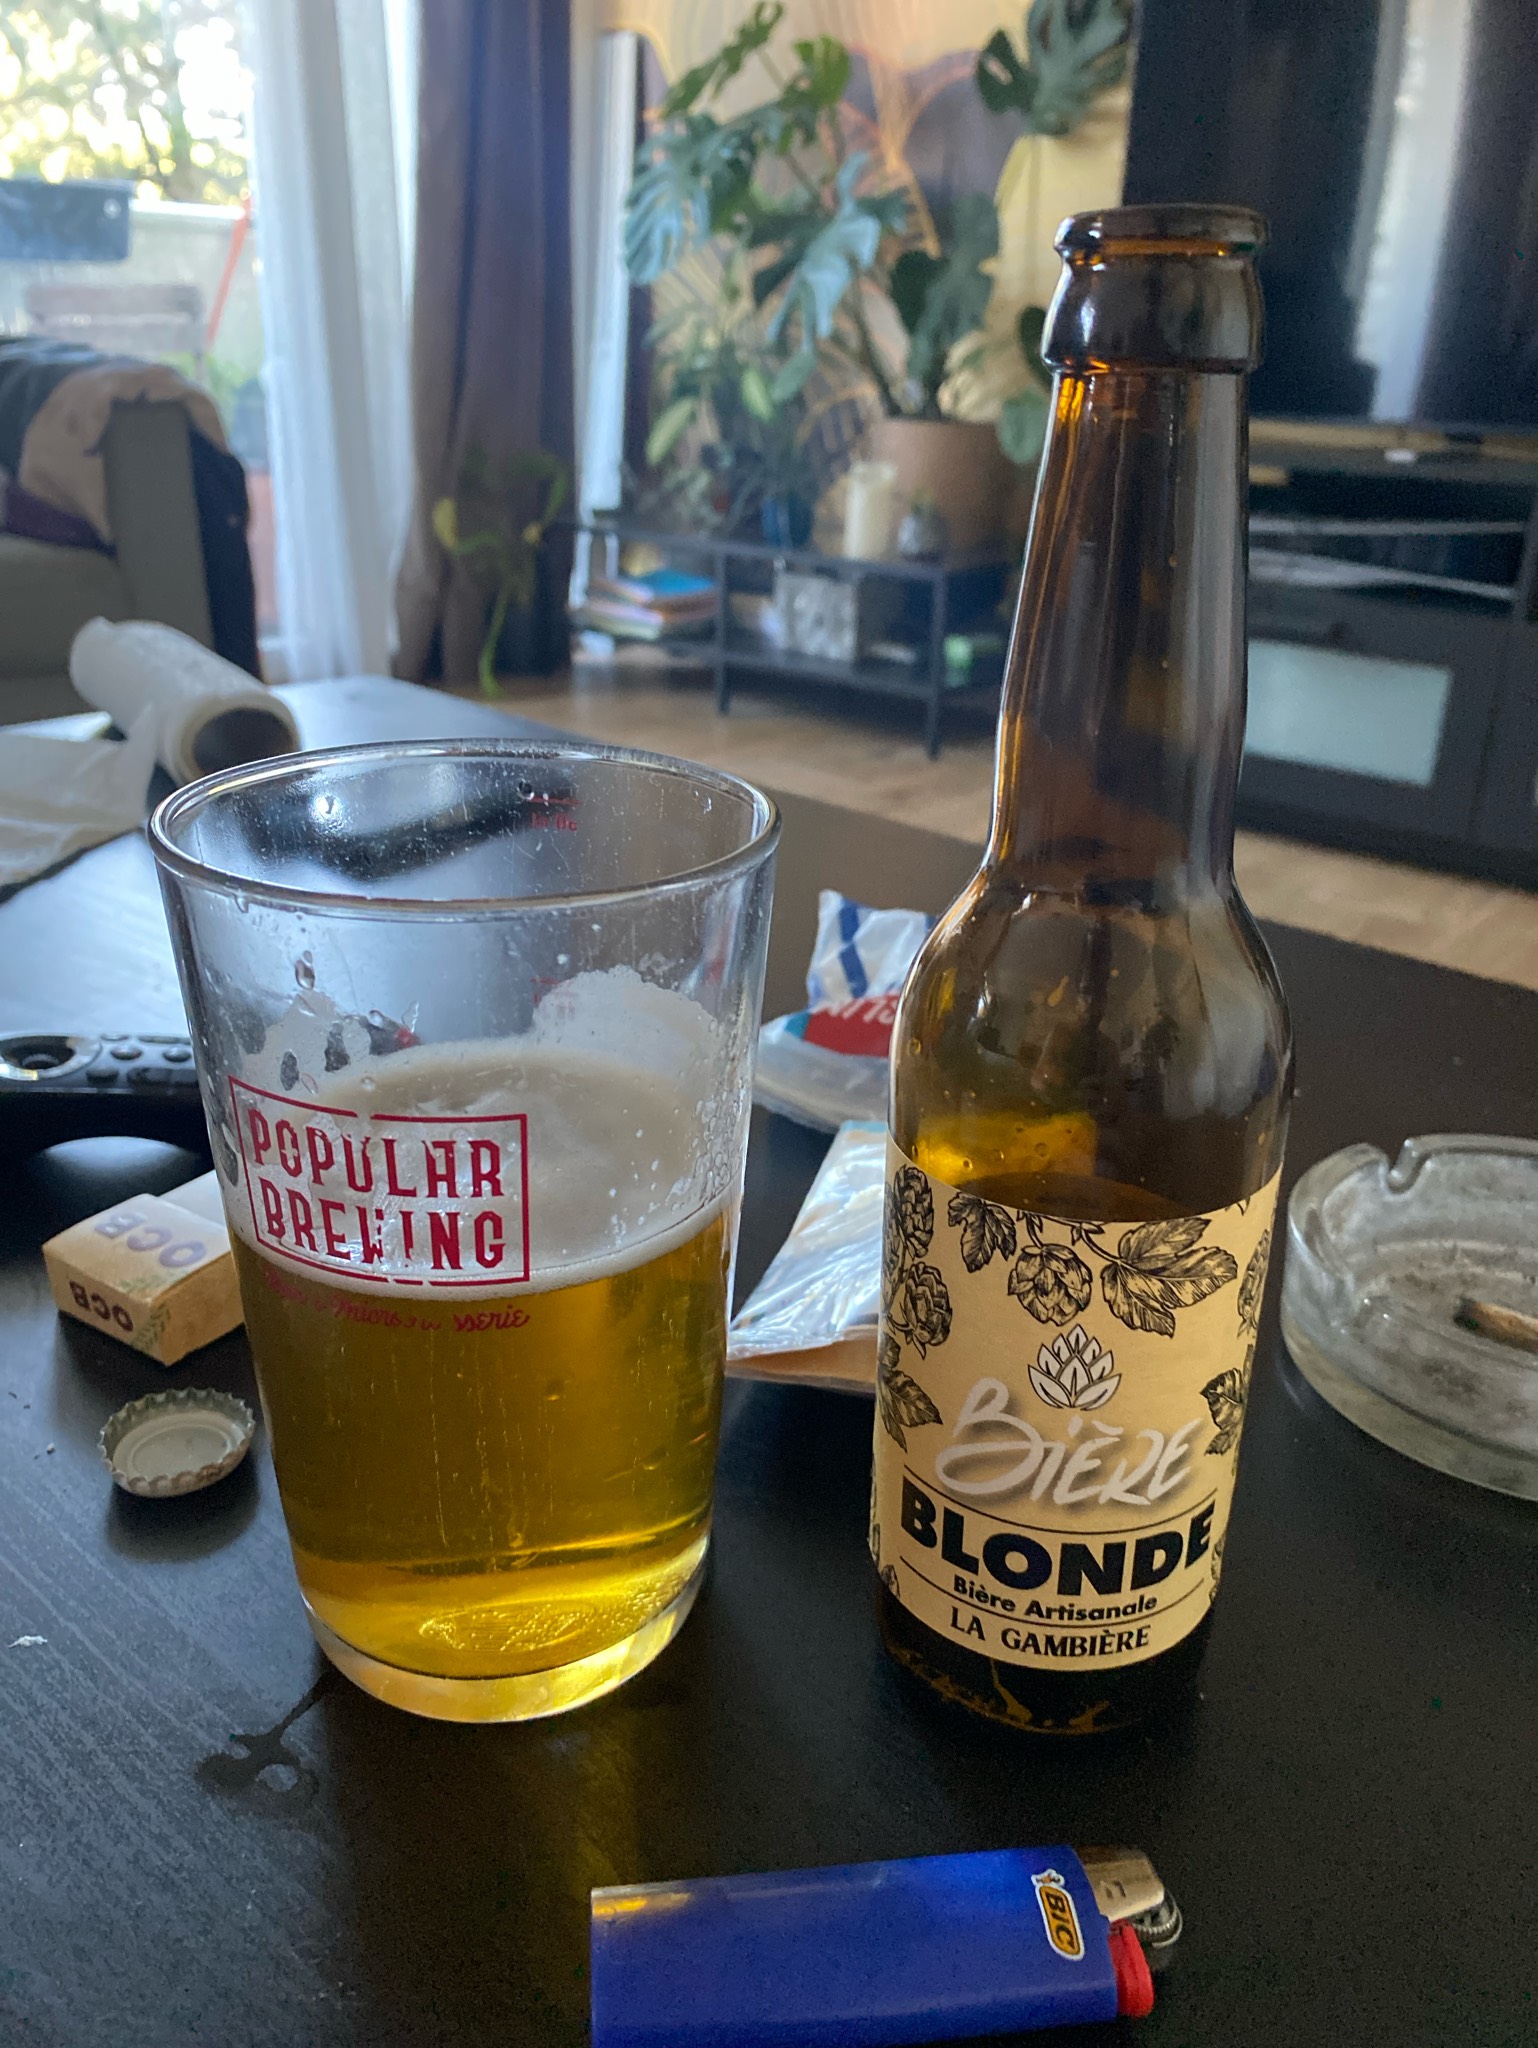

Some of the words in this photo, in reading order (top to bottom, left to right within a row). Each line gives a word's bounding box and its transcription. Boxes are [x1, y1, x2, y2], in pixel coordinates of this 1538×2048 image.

[247, 1107, 504, 1198] POPULAR
[94, 1212, 207, 1268] OCB
[258, 1176, 506, 1270] BREWING
[69, 1280, 134, 1332] OCB
[900, 1475, 1216, 1596] BLONDE
[953, 1574, 1016, 1612] Bière
[1023, 1594, 1158, 1621] Artisanale
[950, 1606, 986, 1641] LA
[1000, 1624, 1152, 1657] GAMBIÈRE
[1046, 1890, 1076, 1951] BIC
